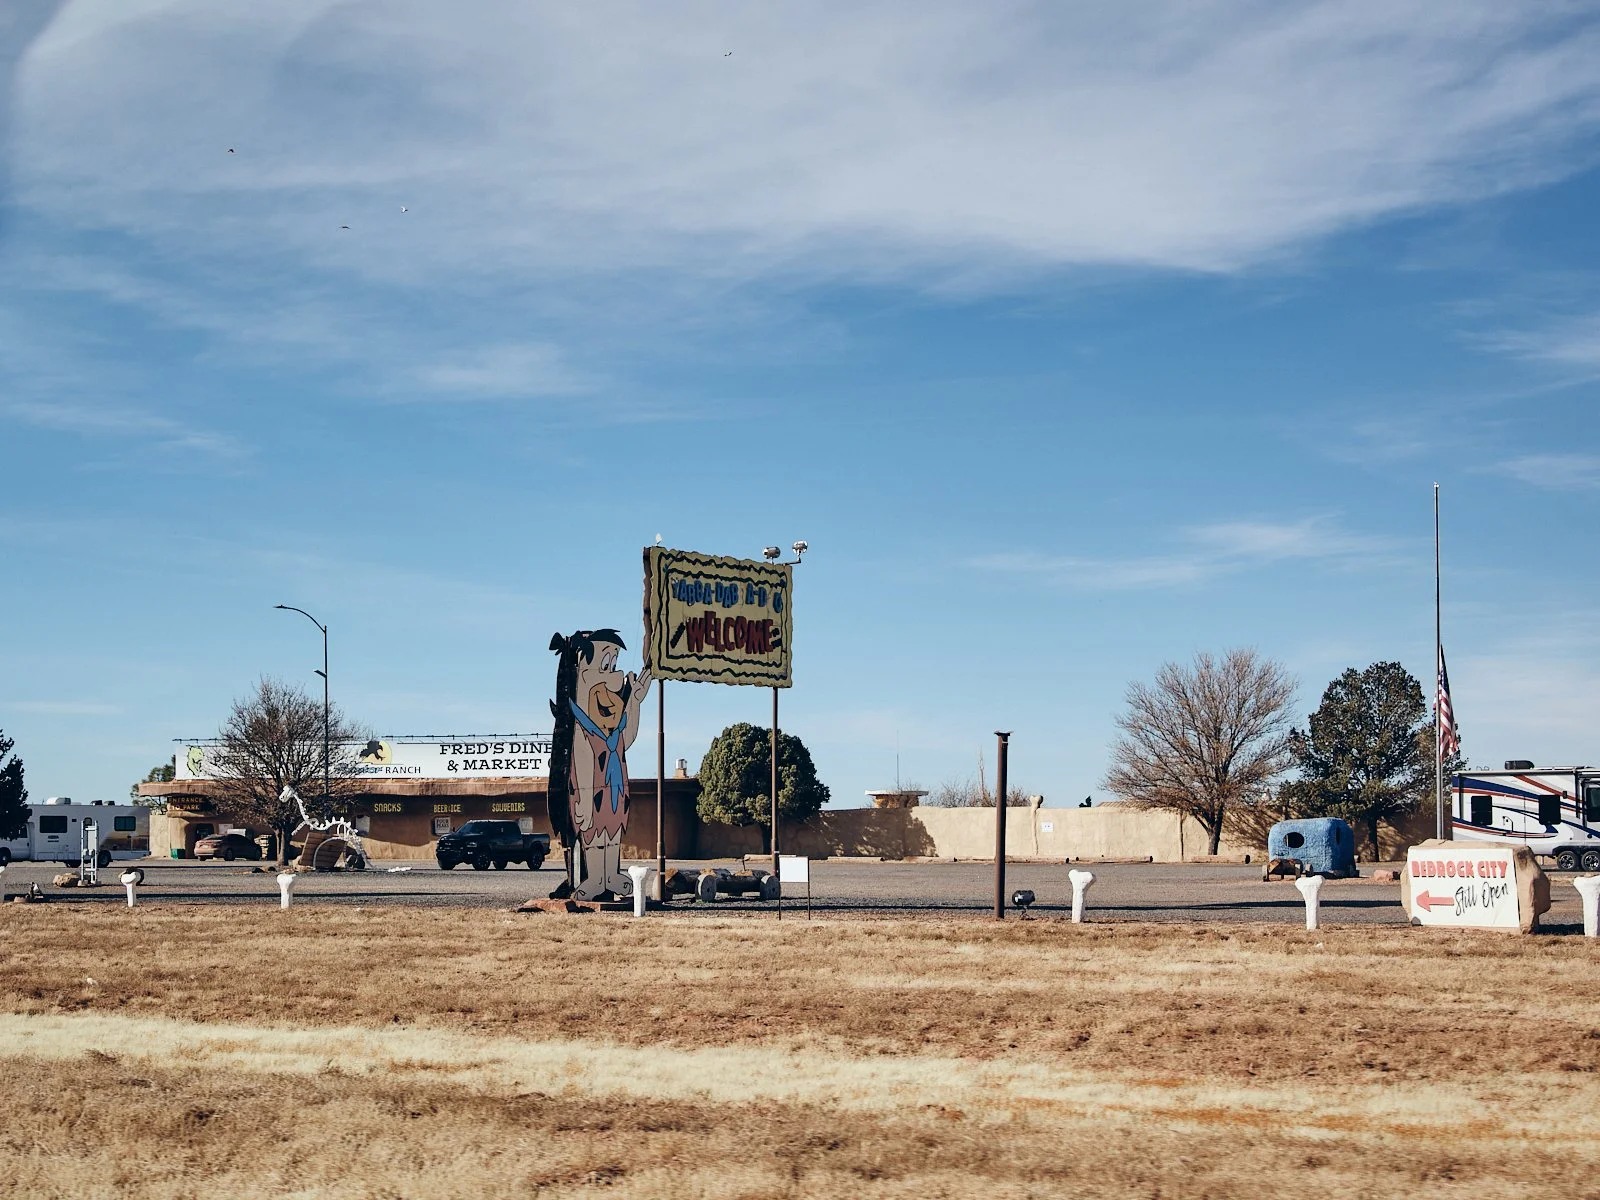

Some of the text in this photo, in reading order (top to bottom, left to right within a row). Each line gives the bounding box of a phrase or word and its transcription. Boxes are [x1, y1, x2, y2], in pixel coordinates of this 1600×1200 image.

[686, 610, 774, 654] WELCOME
[440, 742, 504, 755] FRED'S
[385, 766, 421, 774] RANCH
[447, 759, 459, 773] &
[463, 759, 541, 770] MARKET
[374, 803, 401, 813] SNACKS
[433, 804, 448, 813] BEER
[450, 804, 462, 813] ICE
[491, 802, 525, 813] SOUVENIRS
[1411, 860, 1508, 879] BEDROCK CITY
[1455, 881, 1509, 917] Still Open
